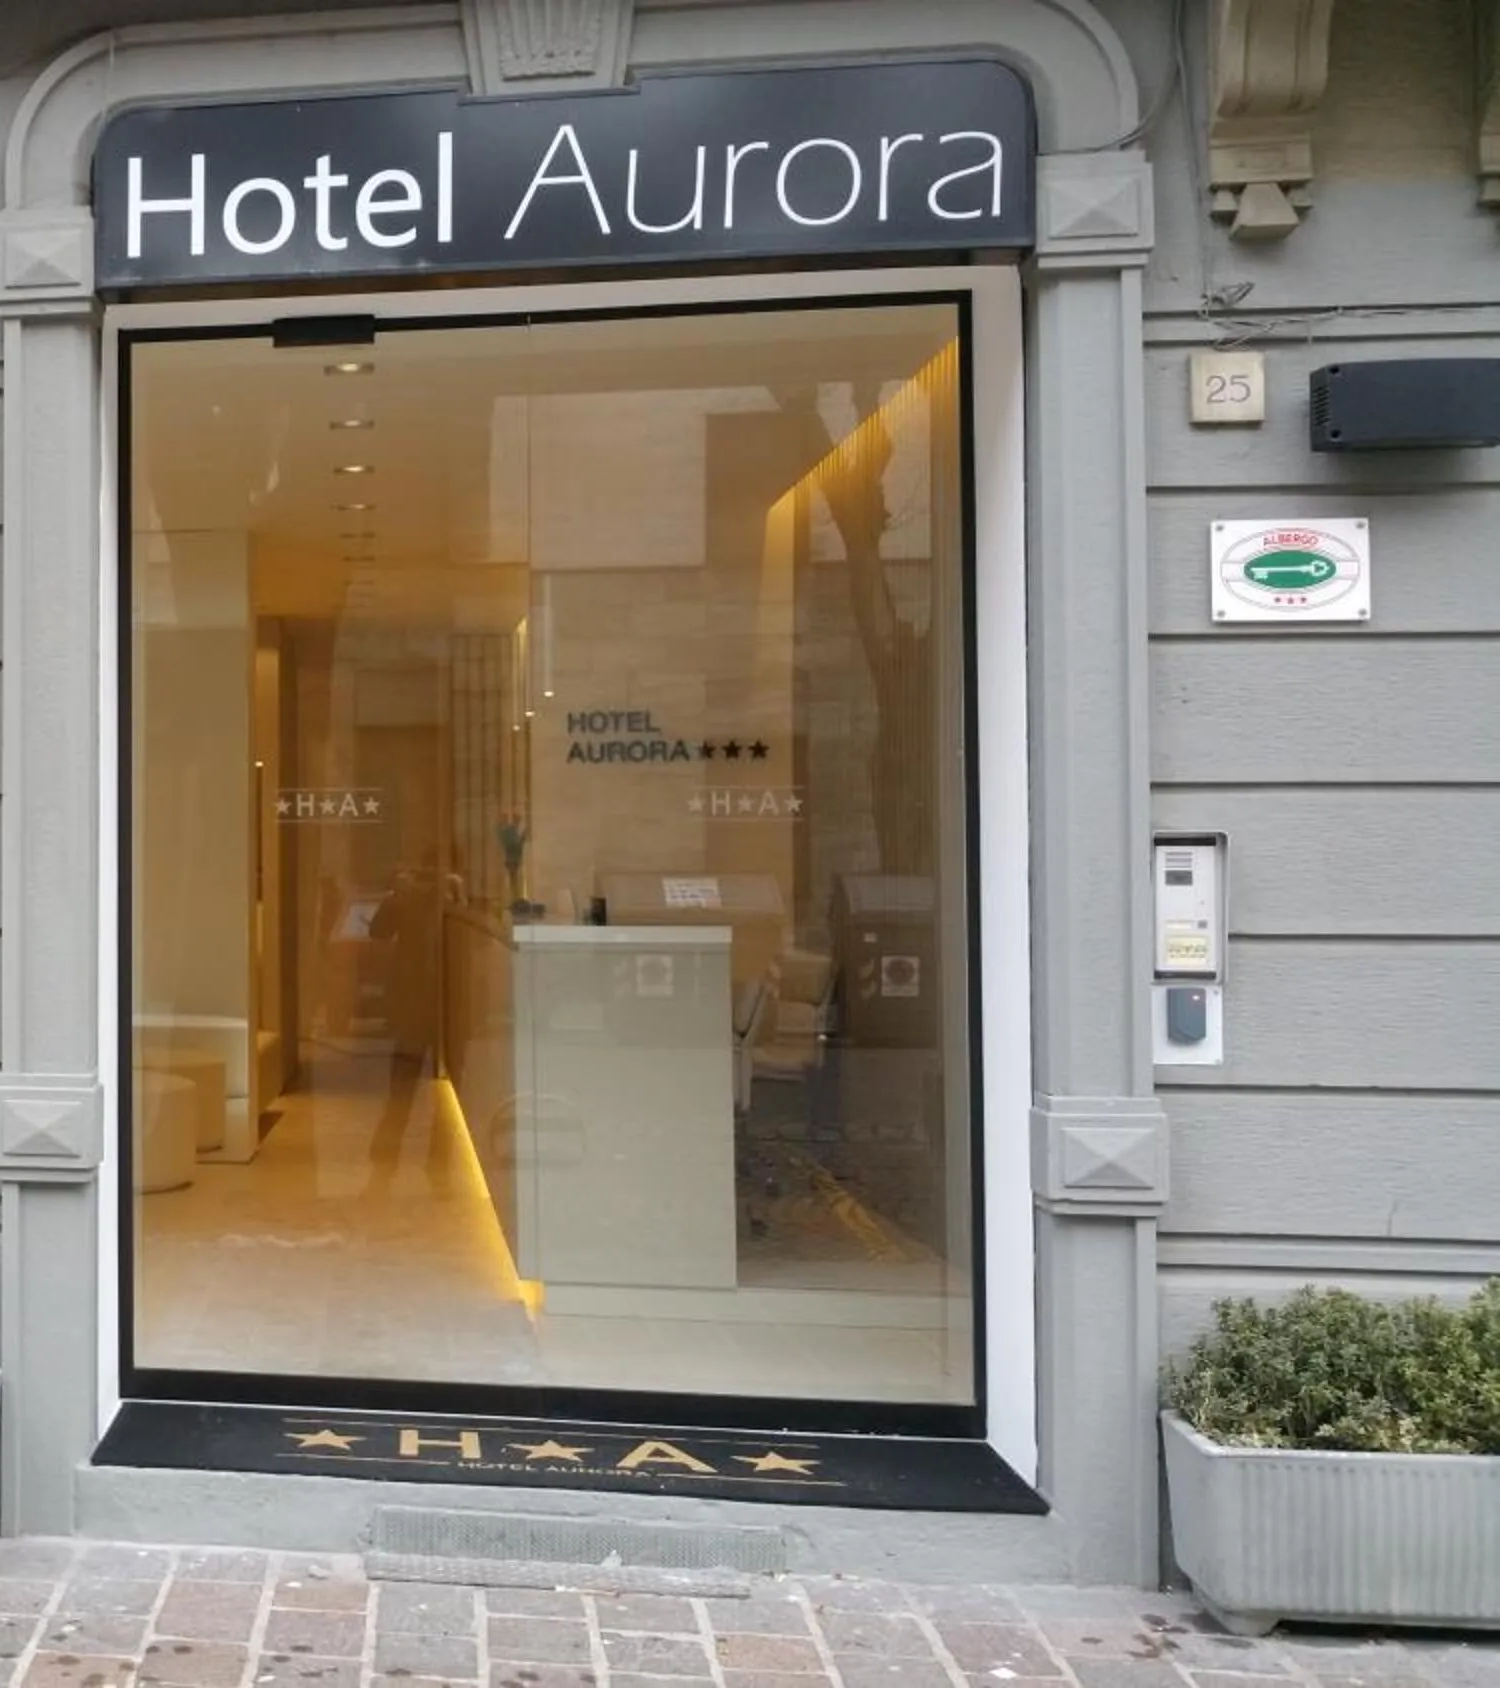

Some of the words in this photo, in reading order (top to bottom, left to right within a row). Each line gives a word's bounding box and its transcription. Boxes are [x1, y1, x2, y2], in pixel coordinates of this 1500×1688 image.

[125, 130, 454, 259] Hotel
[504, 123, 1005, 241] Aurora
[1204, 375, 1252, 405] 25
[1262, 533, 1319, 548] ALBERGO
[566, 710, 661, 734] HOTEL
[566, 739, 691, 764] AURORA
